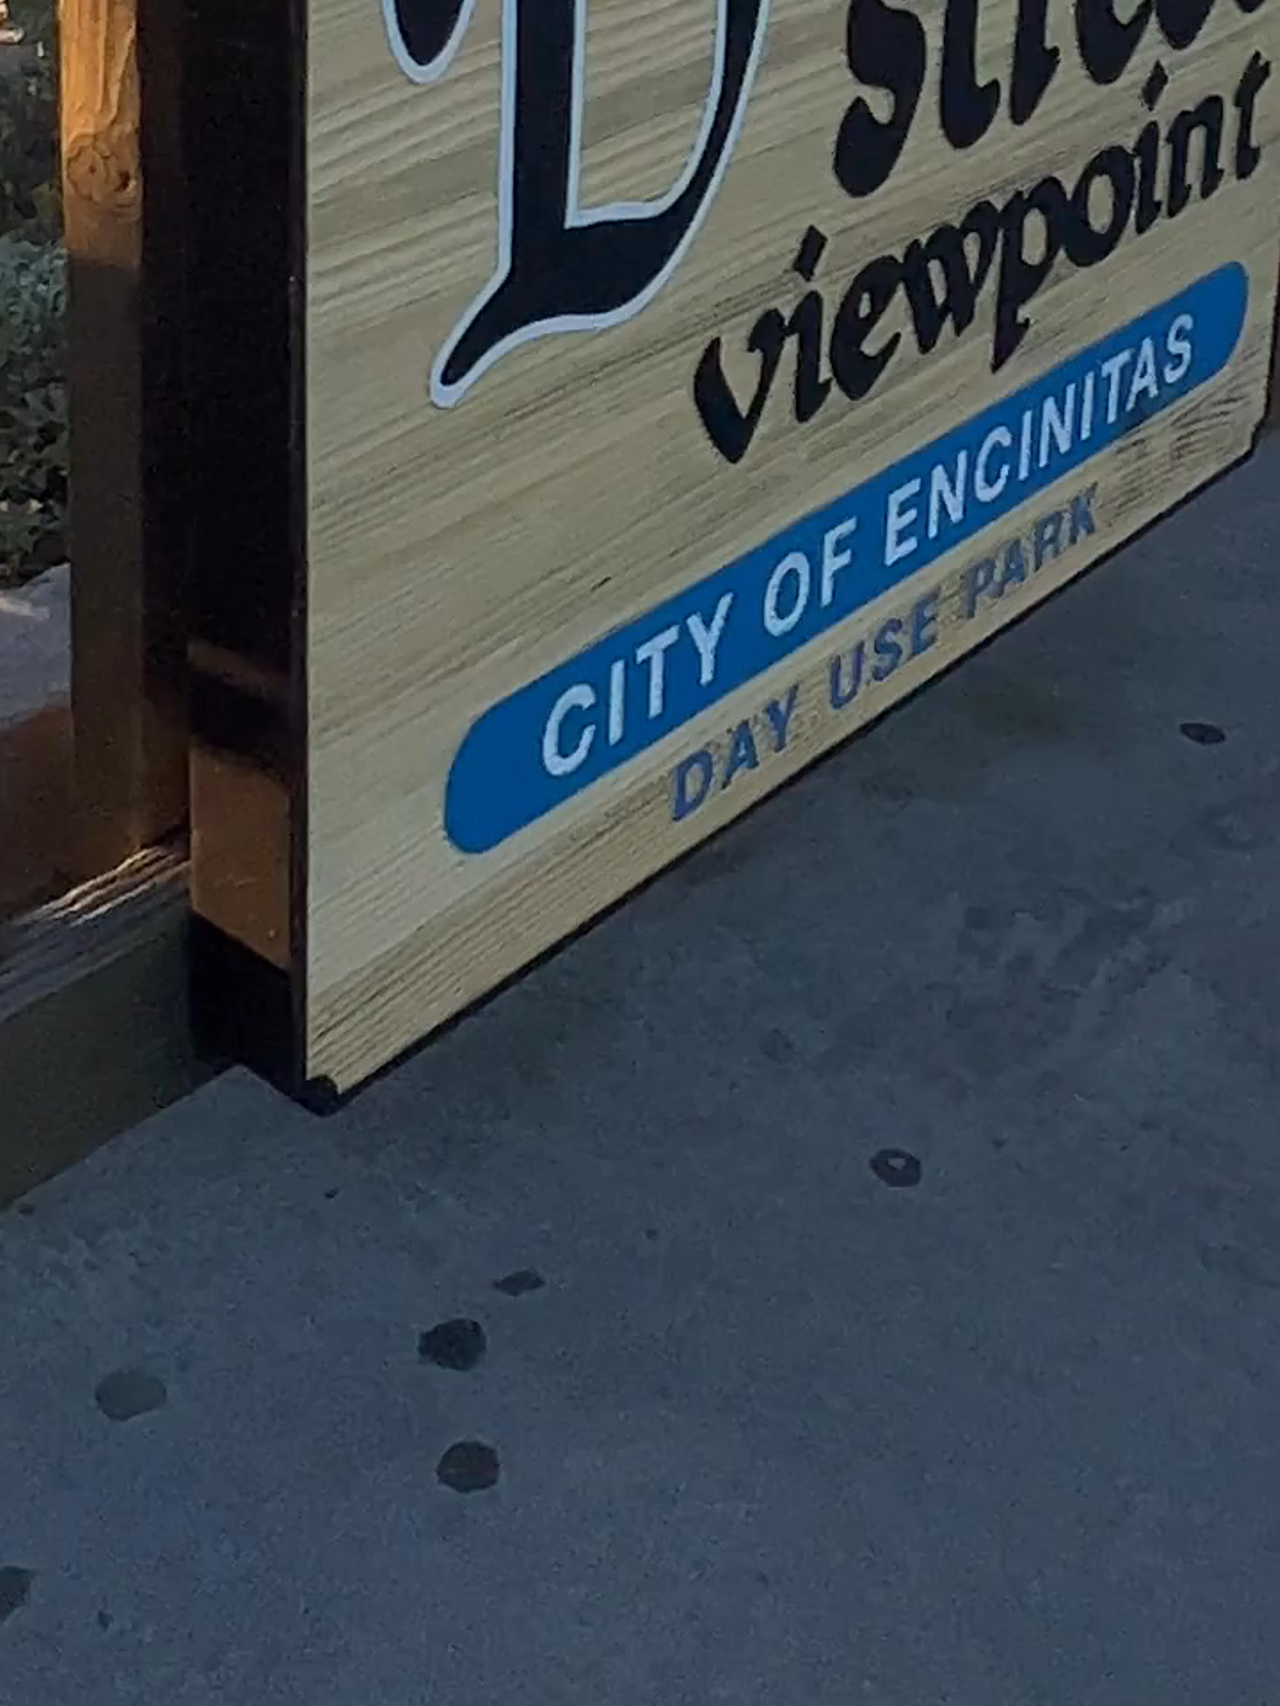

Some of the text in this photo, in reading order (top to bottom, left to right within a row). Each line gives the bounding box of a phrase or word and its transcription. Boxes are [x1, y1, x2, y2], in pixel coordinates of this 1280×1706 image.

[694, 51, 1270, 464] viewpoint
[541, 313, 1194, 777] CITY OF ENCINITAS
[670, 484, 1100, 824] DAY USE PARK
